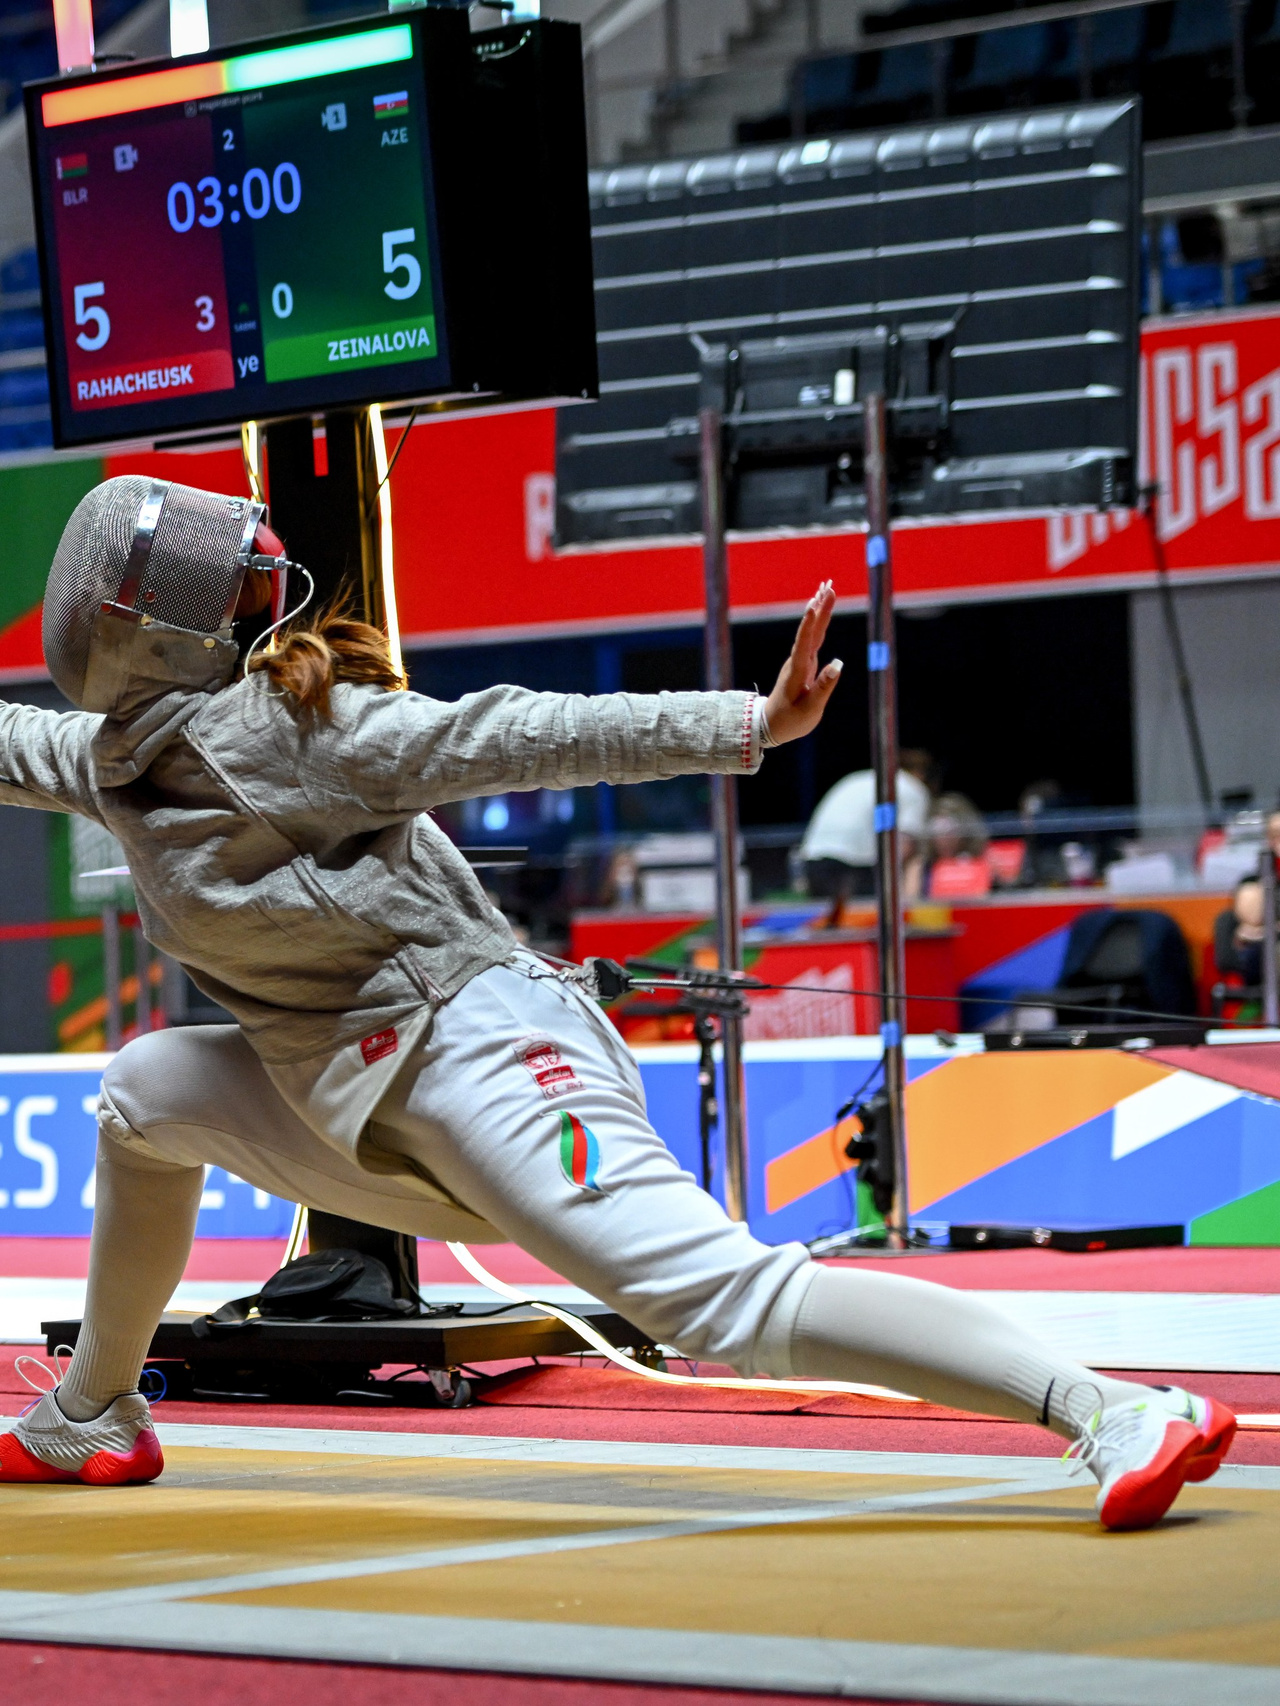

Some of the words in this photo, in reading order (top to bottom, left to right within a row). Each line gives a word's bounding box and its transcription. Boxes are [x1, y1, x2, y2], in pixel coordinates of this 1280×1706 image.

[222, 129, 235, 151] 2
[381, 127, 410, 148] AZE
[62, 187, 89, 207] BLR
[167, 162, 302, 233] 03:00
[381, 227, 422, 301] 5
[73, 281, 111, 352] 5
[194, 295, 216, 332] 3
[271, 282, 294, 319] 0
[327, 327, 431, 362] ZEINALOVA
[77, 363, 194, 401] RAHACHEUSK
[237, 354, 260, 379] ye
